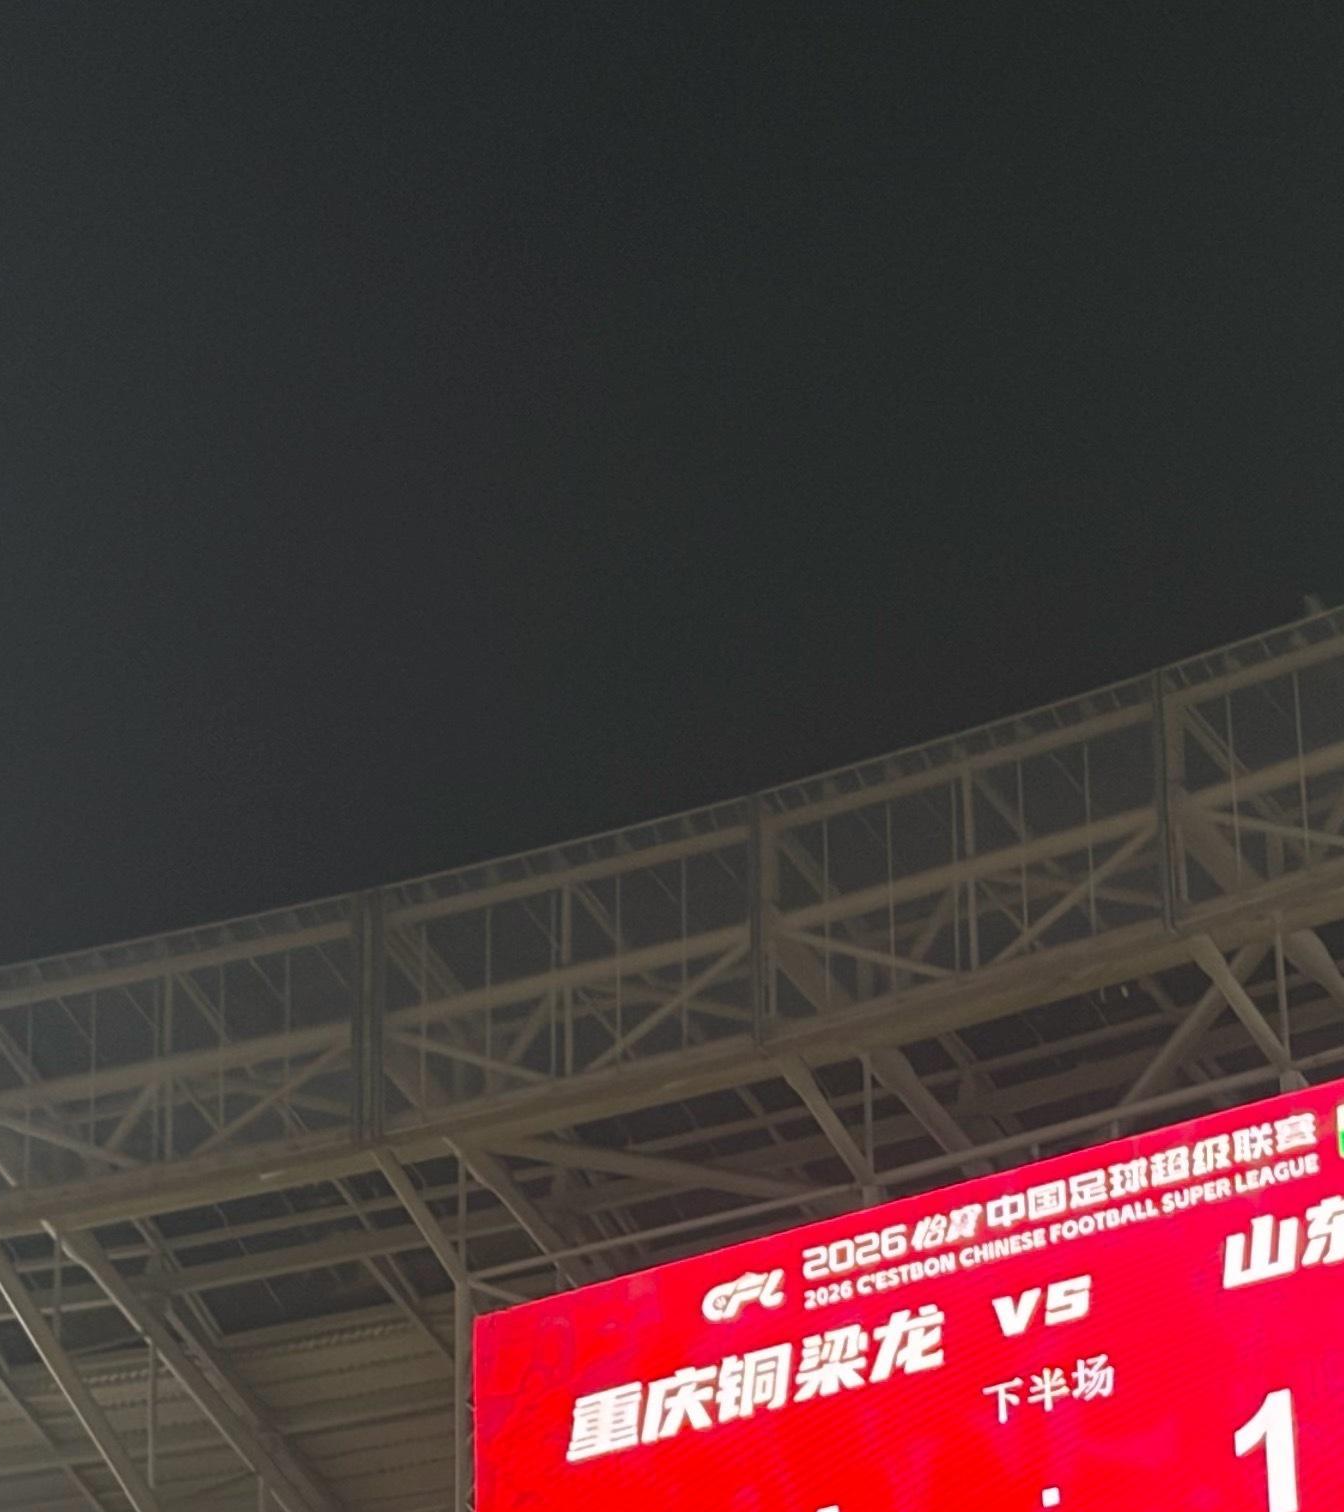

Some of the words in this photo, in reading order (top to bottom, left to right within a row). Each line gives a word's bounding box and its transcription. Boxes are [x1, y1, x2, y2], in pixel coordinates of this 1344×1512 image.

[804, 1279, 854, 1310] 2026
[958, 1227, 1047, 1268] CHINESE
[1049, 1198, 1160, 1244] FOOTBALL
[1161, 1176, 1233, 1214] SUPER
[1234, 1153, 1320, 1194] LEAGUE
[566, 1304, 946, 1463] 重庆铜梁龙
[983, 1353, 1115, 1424] 下半场
